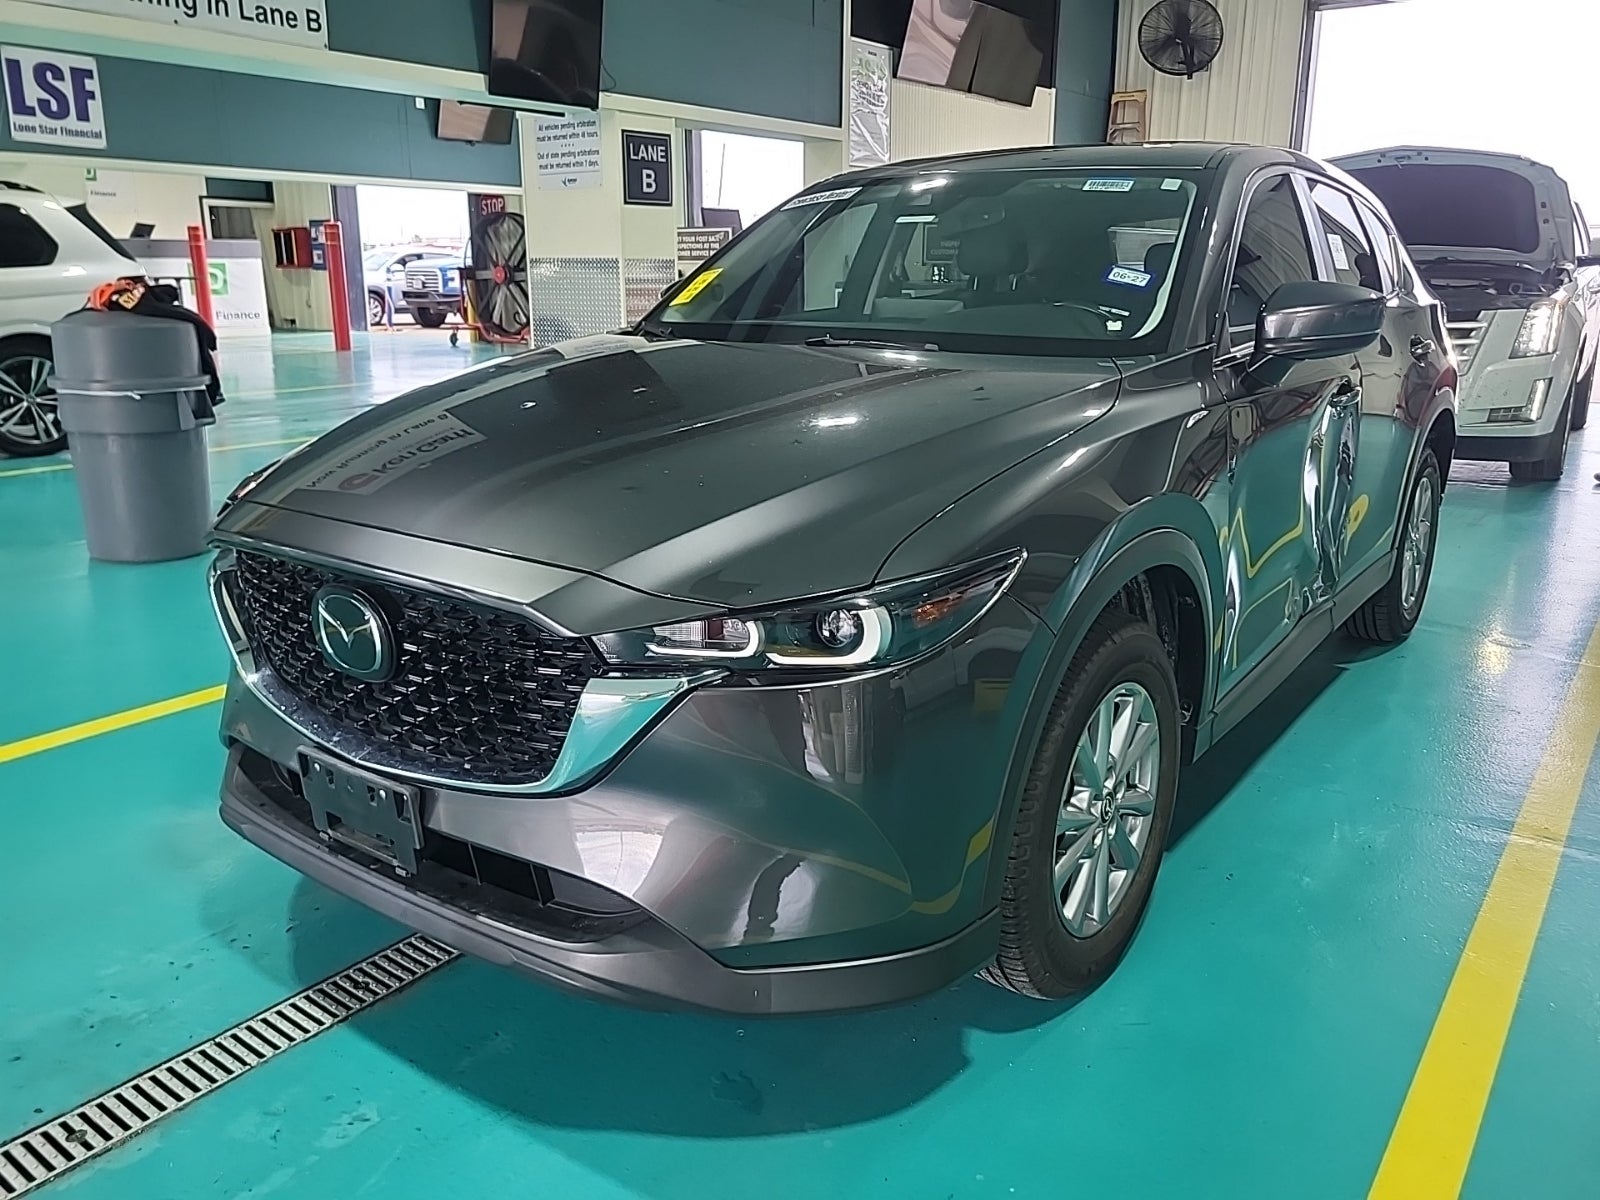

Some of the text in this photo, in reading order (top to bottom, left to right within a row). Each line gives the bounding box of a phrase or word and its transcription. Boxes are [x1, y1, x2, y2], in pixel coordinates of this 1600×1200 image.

[239, 0, 299, 29] Lane
[305, 8, 322, 33] B
[4, 57, 96, 123] LSF
[13, 121, 103, 140] Lone Star Financial
[629, 142, 667, 163] LANE
[642, 168, 657, 193] B
[481, 198, 504, 216] STOP
[678, 242, 703, 250] SPECTIONS
[215, 310, 261, 321] Finance
